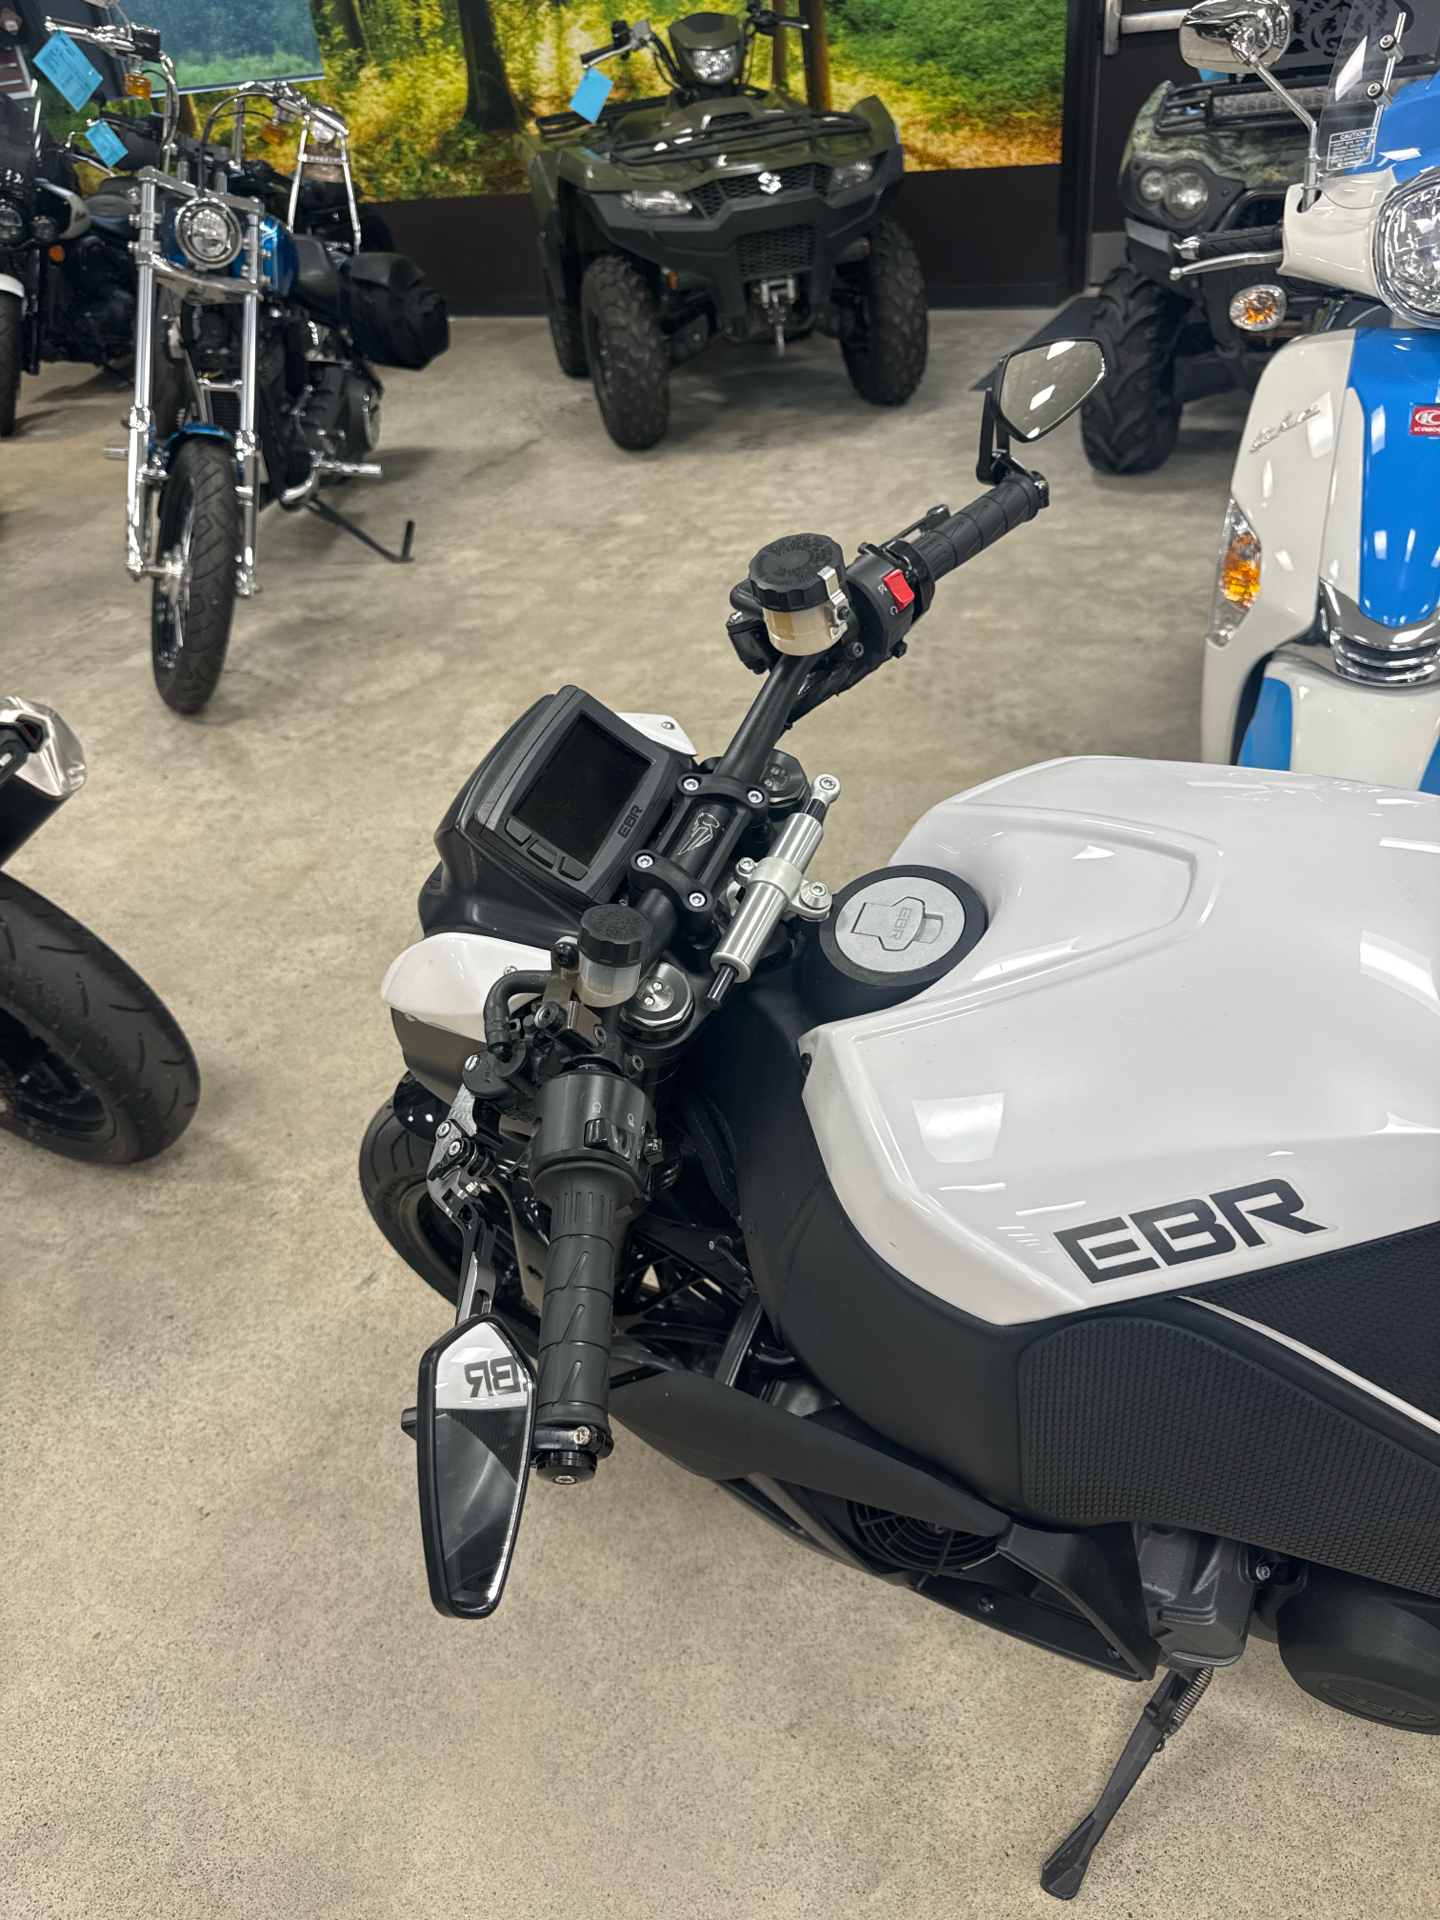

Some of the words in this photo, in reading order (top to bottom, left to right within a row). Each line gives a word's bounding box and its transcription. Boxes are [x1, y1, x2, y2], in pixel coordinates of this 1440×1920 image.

[1339, 131, 1367, 140] CAUTION
[617, 804, 644, 839] EBR
[889, 907, 913, 941] EBR
[1053, 1178, 1328, 1284] EBR
